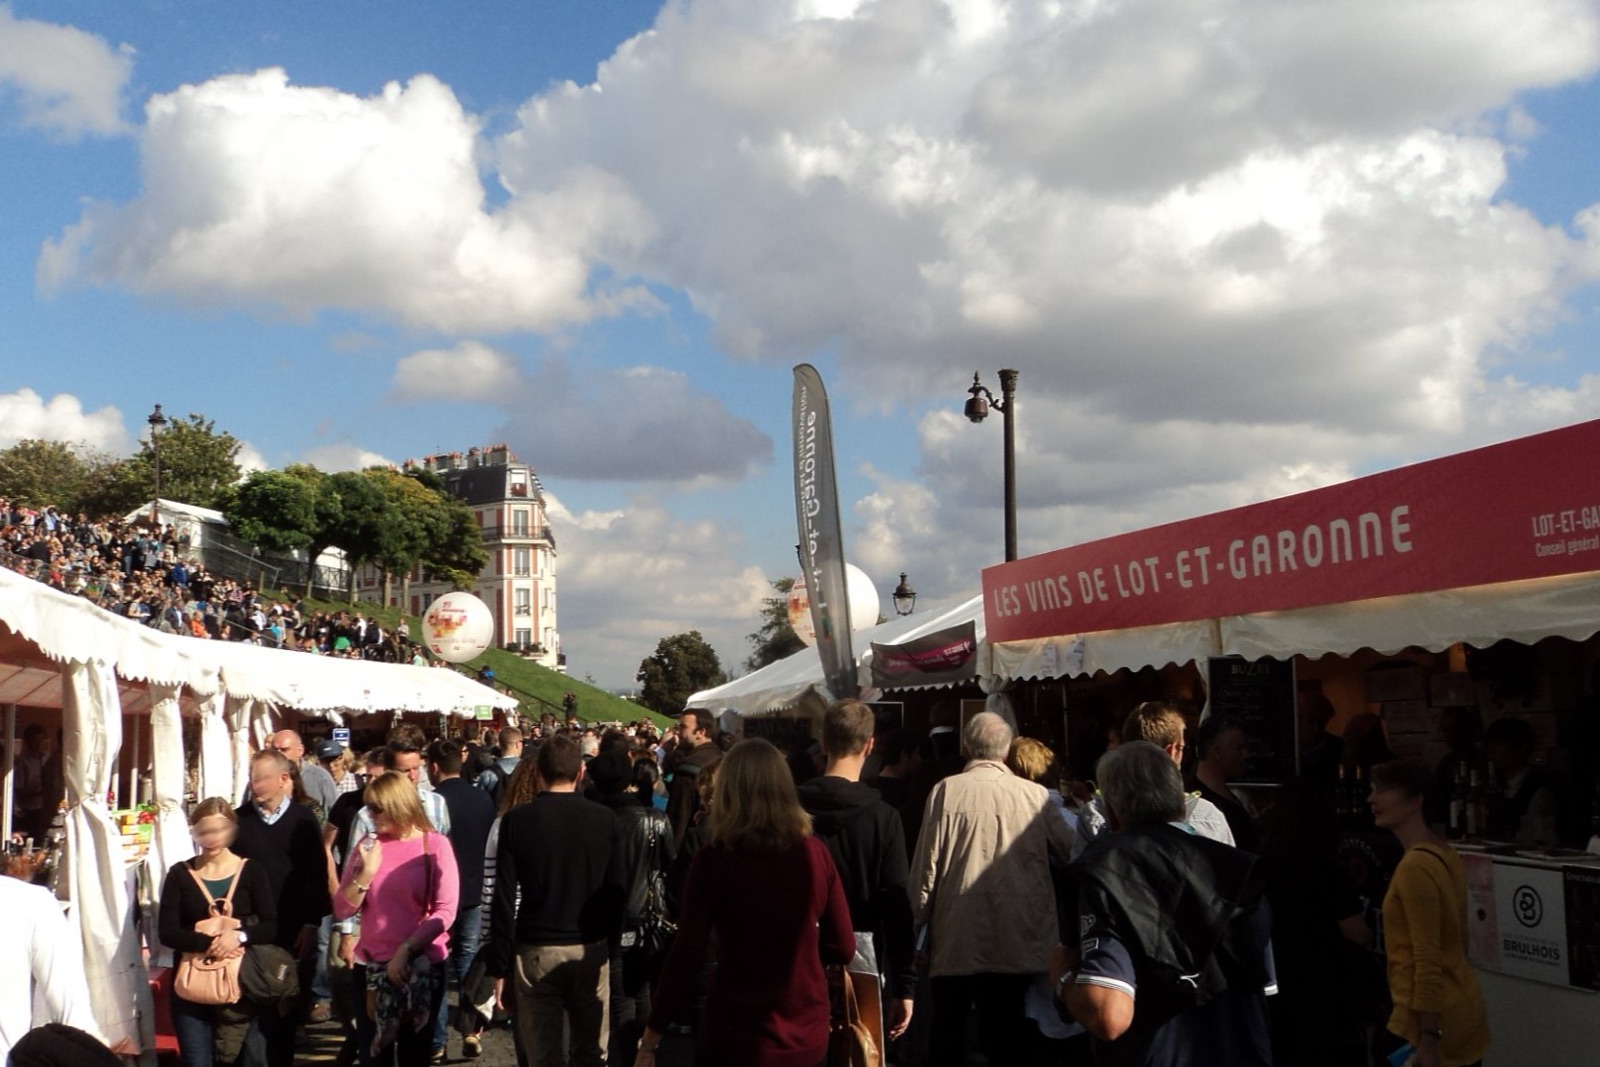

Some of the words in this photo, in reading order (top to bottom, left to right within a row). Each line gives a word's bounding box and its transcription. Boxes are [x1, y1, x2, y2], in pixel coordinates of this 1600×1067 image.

[1531, 505, 1600, 538] LOT-ET-GA
[1535, 539, 1566, 557] Conseil
[1567, 533, 1600, 556] général
[993, 585, 1022, 617] LES
[1025, 571, 1074, 612] VINS
[1078, 567, 1108, 605] DE
[1114, 505, 1414, 600] LOT-ET-GARONNE
[1503, 938, 1561, 961] BRULHOIS
